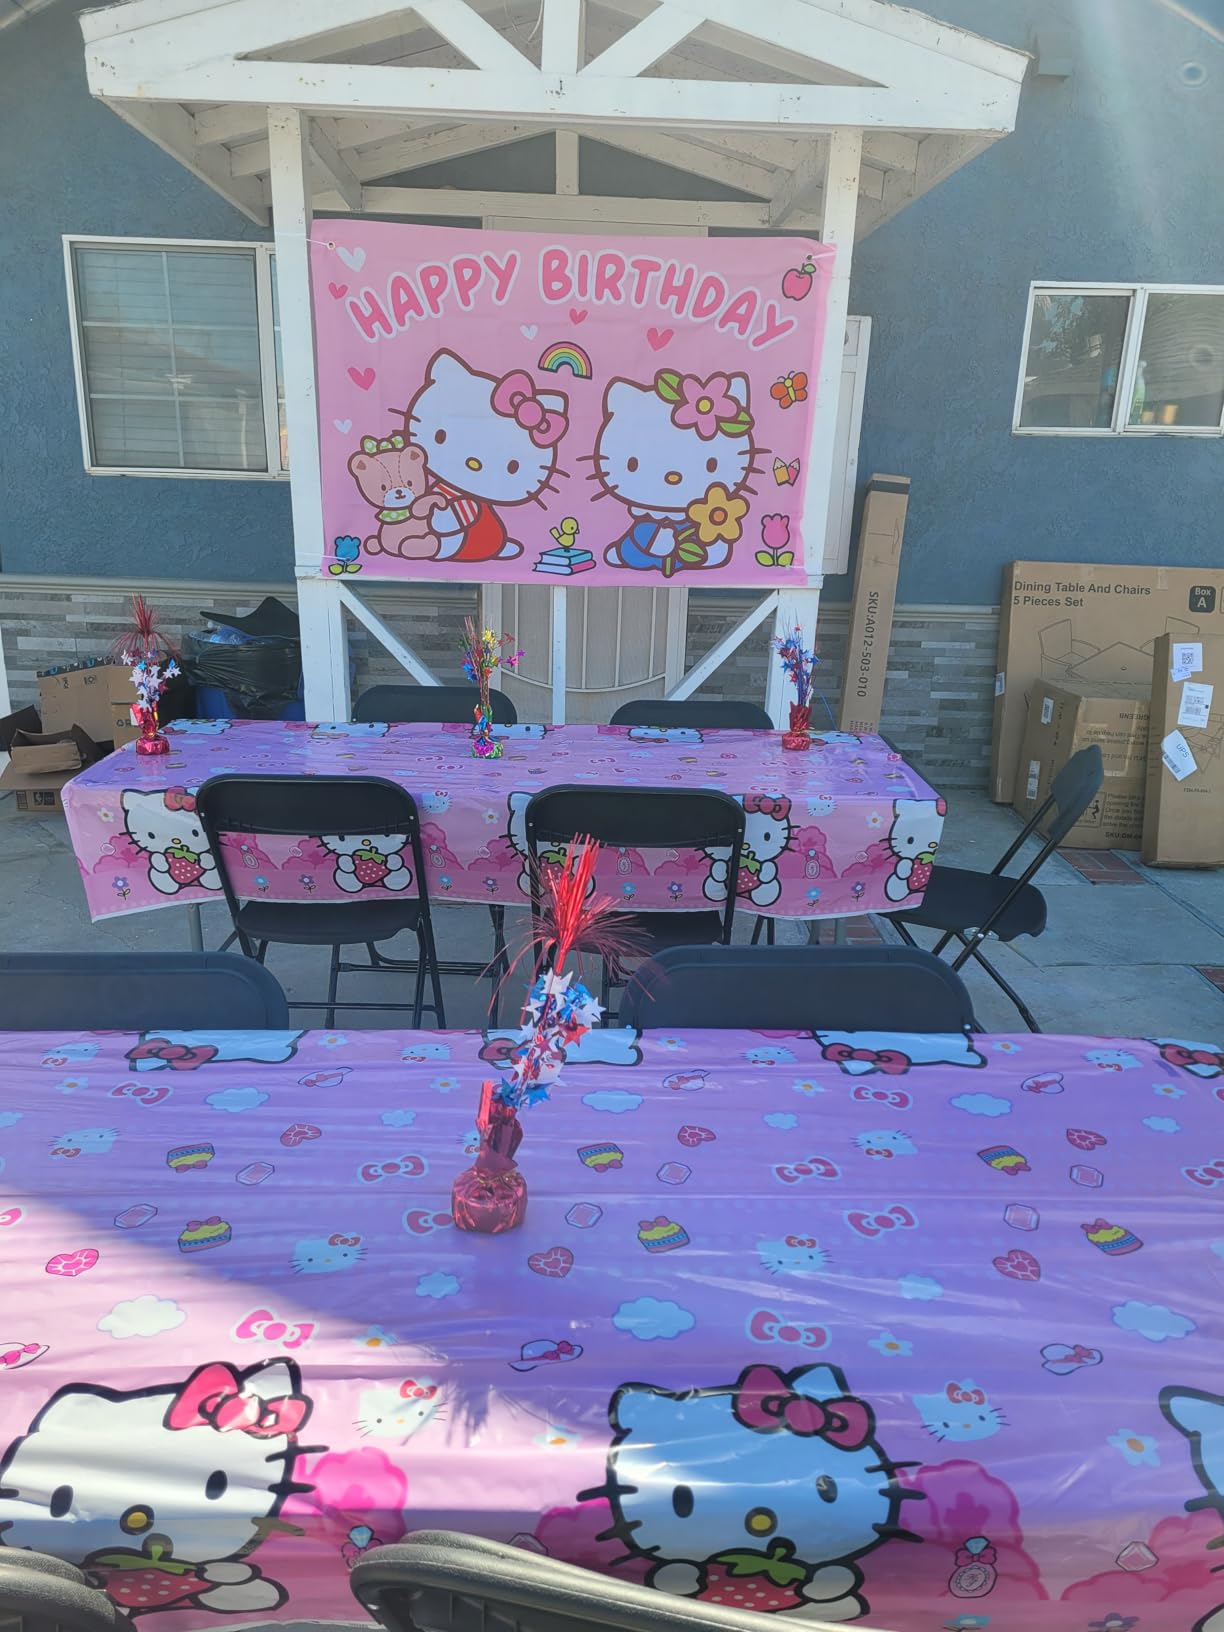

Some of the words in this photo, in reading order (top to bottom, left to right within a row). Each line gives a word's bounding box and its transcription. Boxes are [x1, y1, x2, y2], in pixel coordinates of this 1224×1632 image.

[346, 250, 520, 342] HAPPY
[539, 246, 797, 350] BIRTHDAY
[1014, 581, 1051, 594] Dining
[1055, 582, 1085, 593] Table
[1088, 583, 1111, 594] And
[1114, 584, 1151, 595] Chairs
[1195, 587, 1211, 596] Box
[1013, 595, 1020, 605] 5
[1023, 596, 1061, 607] Pieces
[1064, 596, 1084, 607] Set
[1197, 597, 1207, 608] A
[856, 591, 879, 698] SKU:A012-503-010
[1176, 743, 1190, 758] UPS
